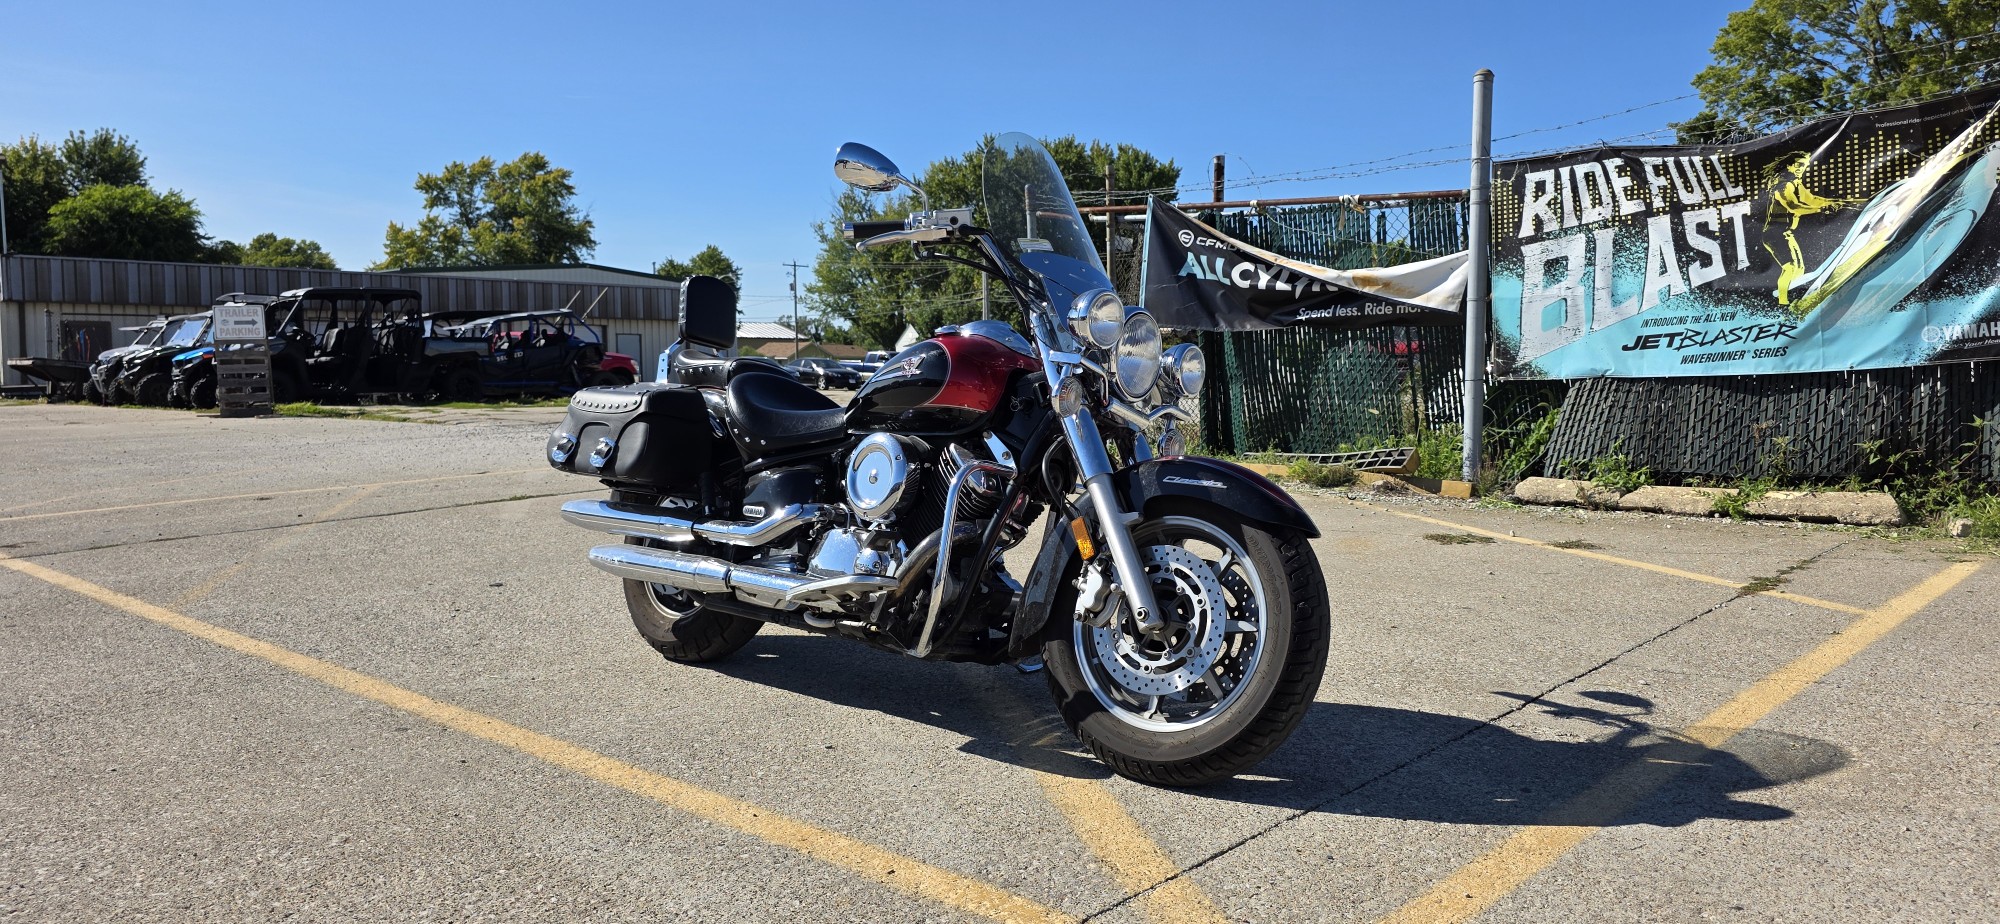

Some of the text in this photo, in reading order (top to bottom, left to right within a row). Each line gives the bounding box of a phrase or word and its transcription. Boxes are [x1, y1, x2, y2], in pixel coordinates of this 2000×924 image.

[1875, 119, 1909, 128] Professional
[1923, 111, 1951, 122] depicted
[1518, 154, 1744, 239] RIDE FULL
[1196, 236, 1244, 252] CFMO
[1515, 200, 1751, 364] BLAST
[217, 308, 259, 318] TRAILER
[1296, 304, 1334, 320] Spend
[1336, 304, 1361, 317] less.
[1364, 302, 1393, 315] Ride
[1640, 311, 1738, 329] INTRODUCING THE ALL-NEW
[219, 327, 261, 337] PARKING
[1751, 346, 1789, 359] SERIES
